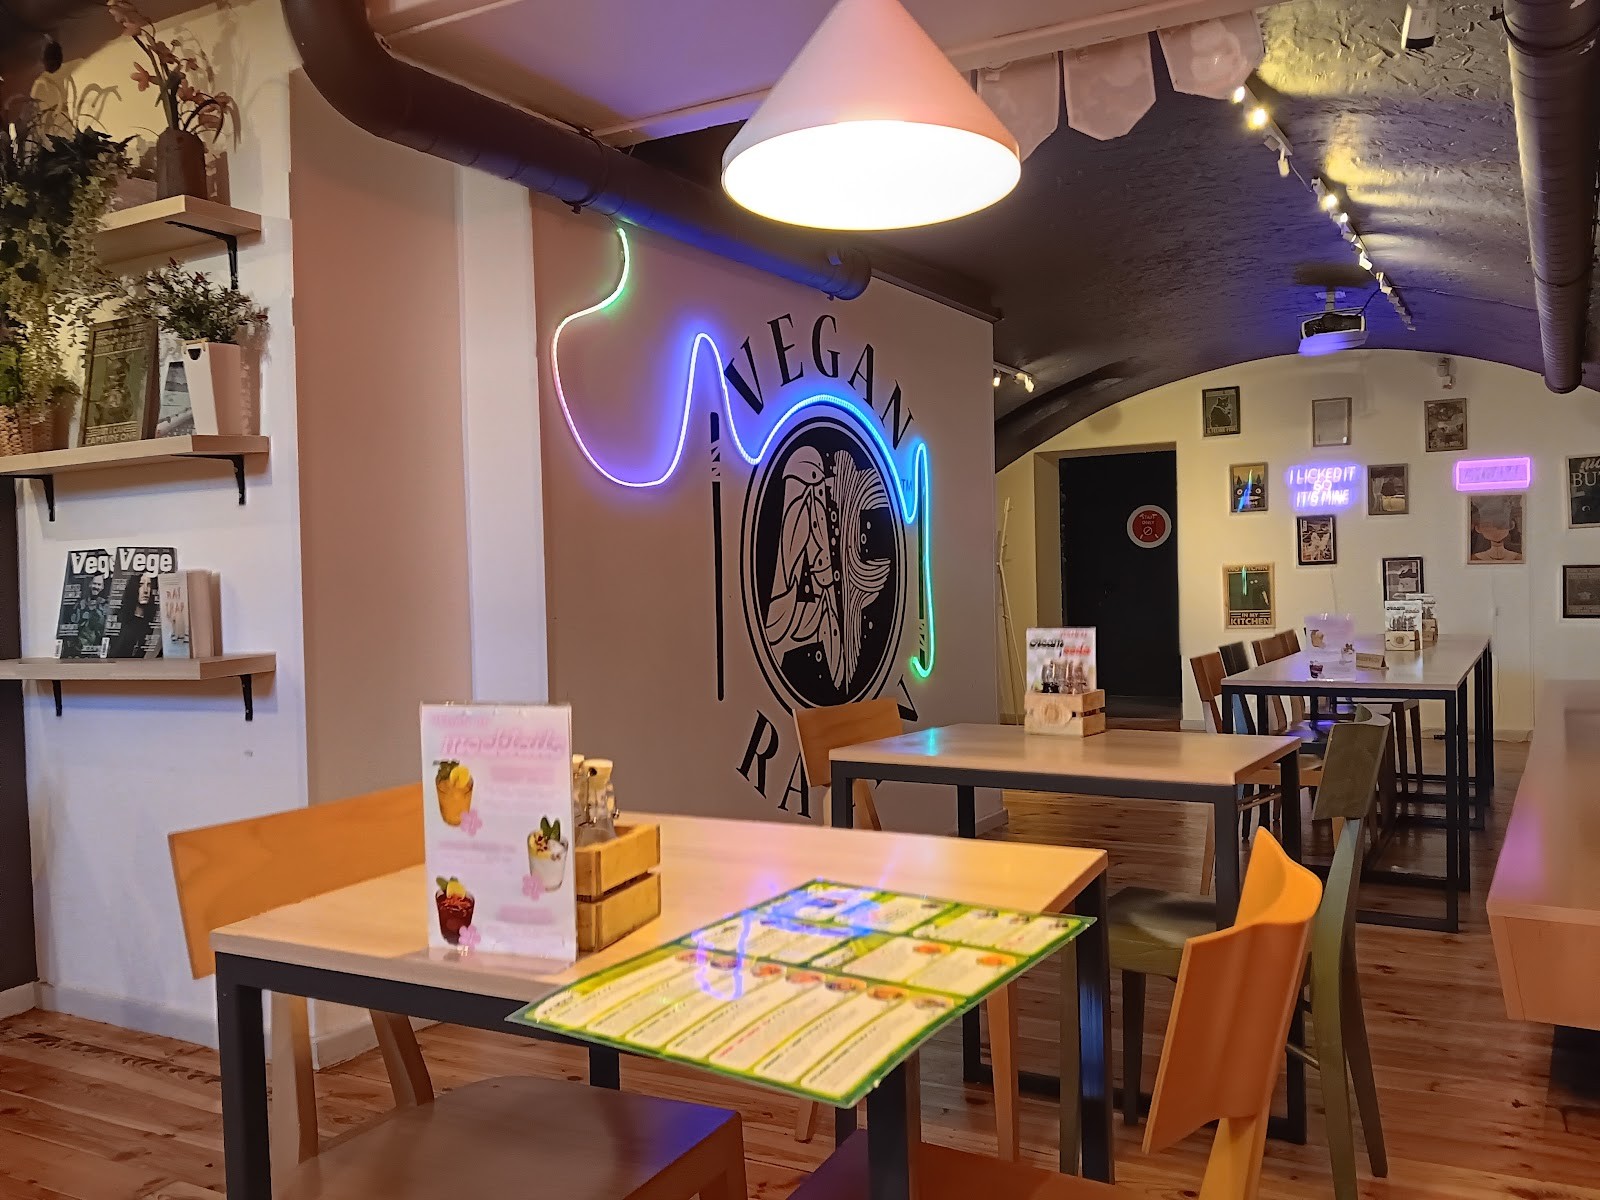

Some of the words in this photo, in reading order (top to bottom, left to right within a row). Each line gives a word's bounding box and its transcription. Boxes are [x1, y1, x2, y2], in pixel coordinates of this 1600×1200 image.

[724, 314, 914, 450] VEGAN
[1296, 467, 1343, 485] LICKED
[1343, 466, 1356, 482] IT
[1571, 471, 1600, 488] BU
[1321, 489, 1349, 506] MINE
[118, 548, 173, 578] Vege
[1230, 617, 1271, 625] KITCHEN
